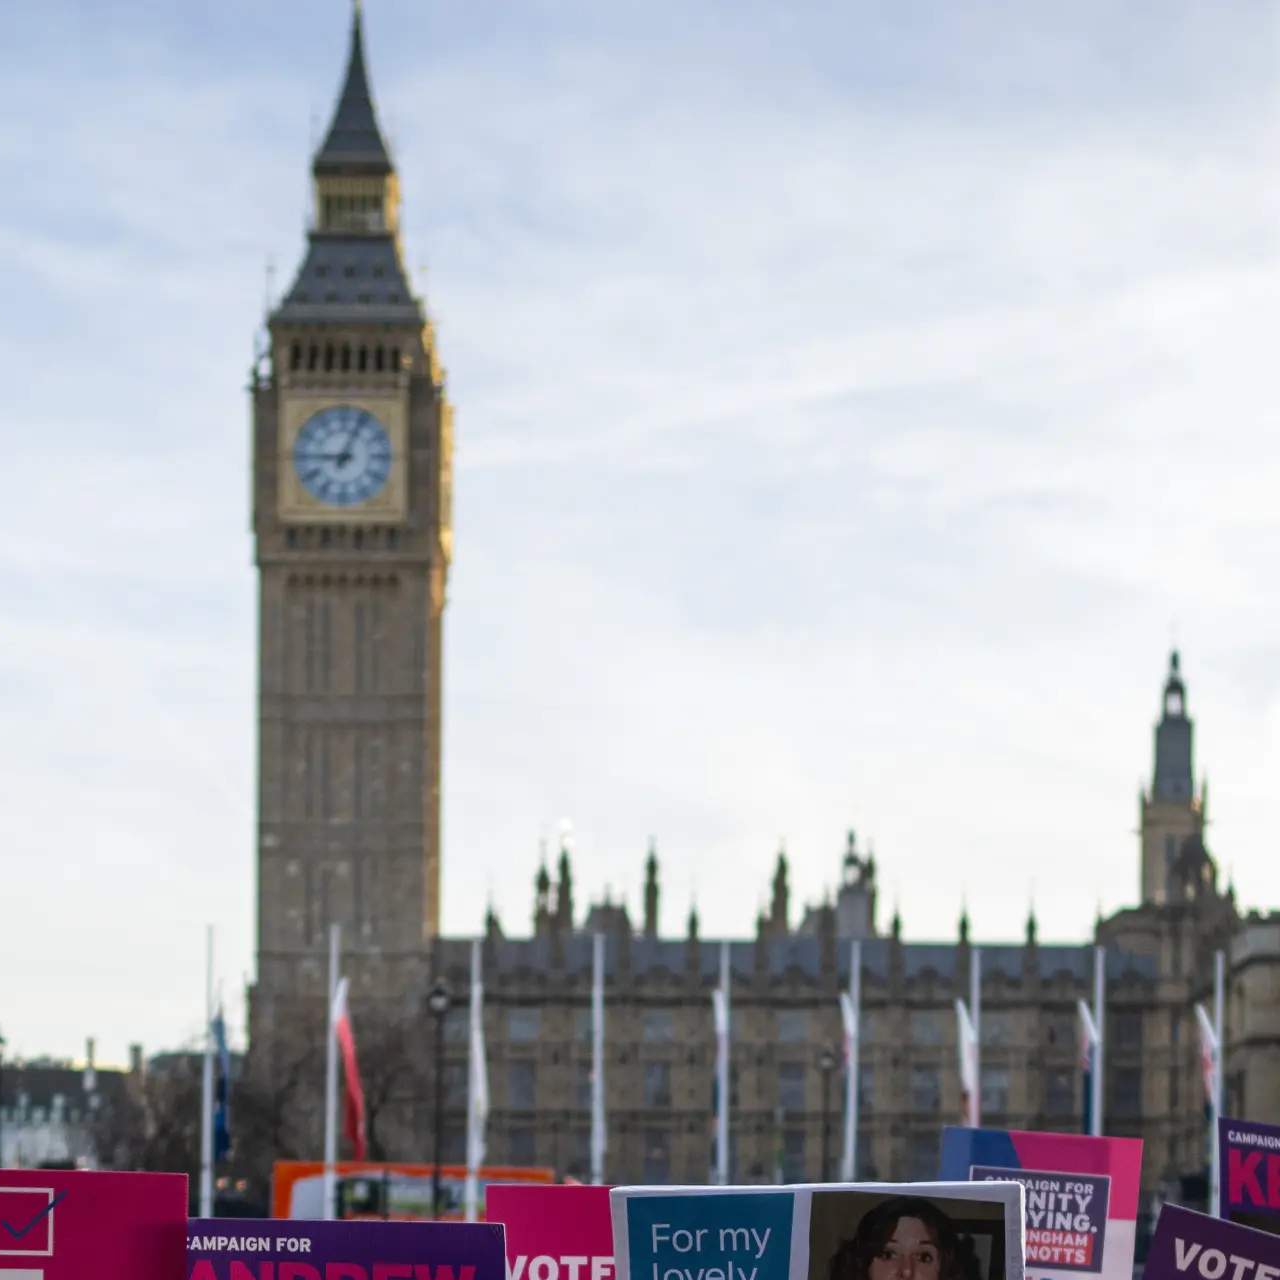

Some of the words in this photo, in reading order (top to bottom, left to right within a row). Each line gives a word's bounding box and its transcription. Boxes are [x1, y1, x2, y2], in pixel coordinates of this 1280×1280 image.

[1228, 1130, 1280, 1152] CAMPAIGN
[1065, 1183, 1094, 1194] FOR
[186, 1236, 269, 1252] AMPAIGN
[276, 1238, 311, 1252] FOR
[652, 1223, 708, 1253] For
[719, 1227, 772, 1258] my
[1026, 1247, 1085, 1262] NOTTS
